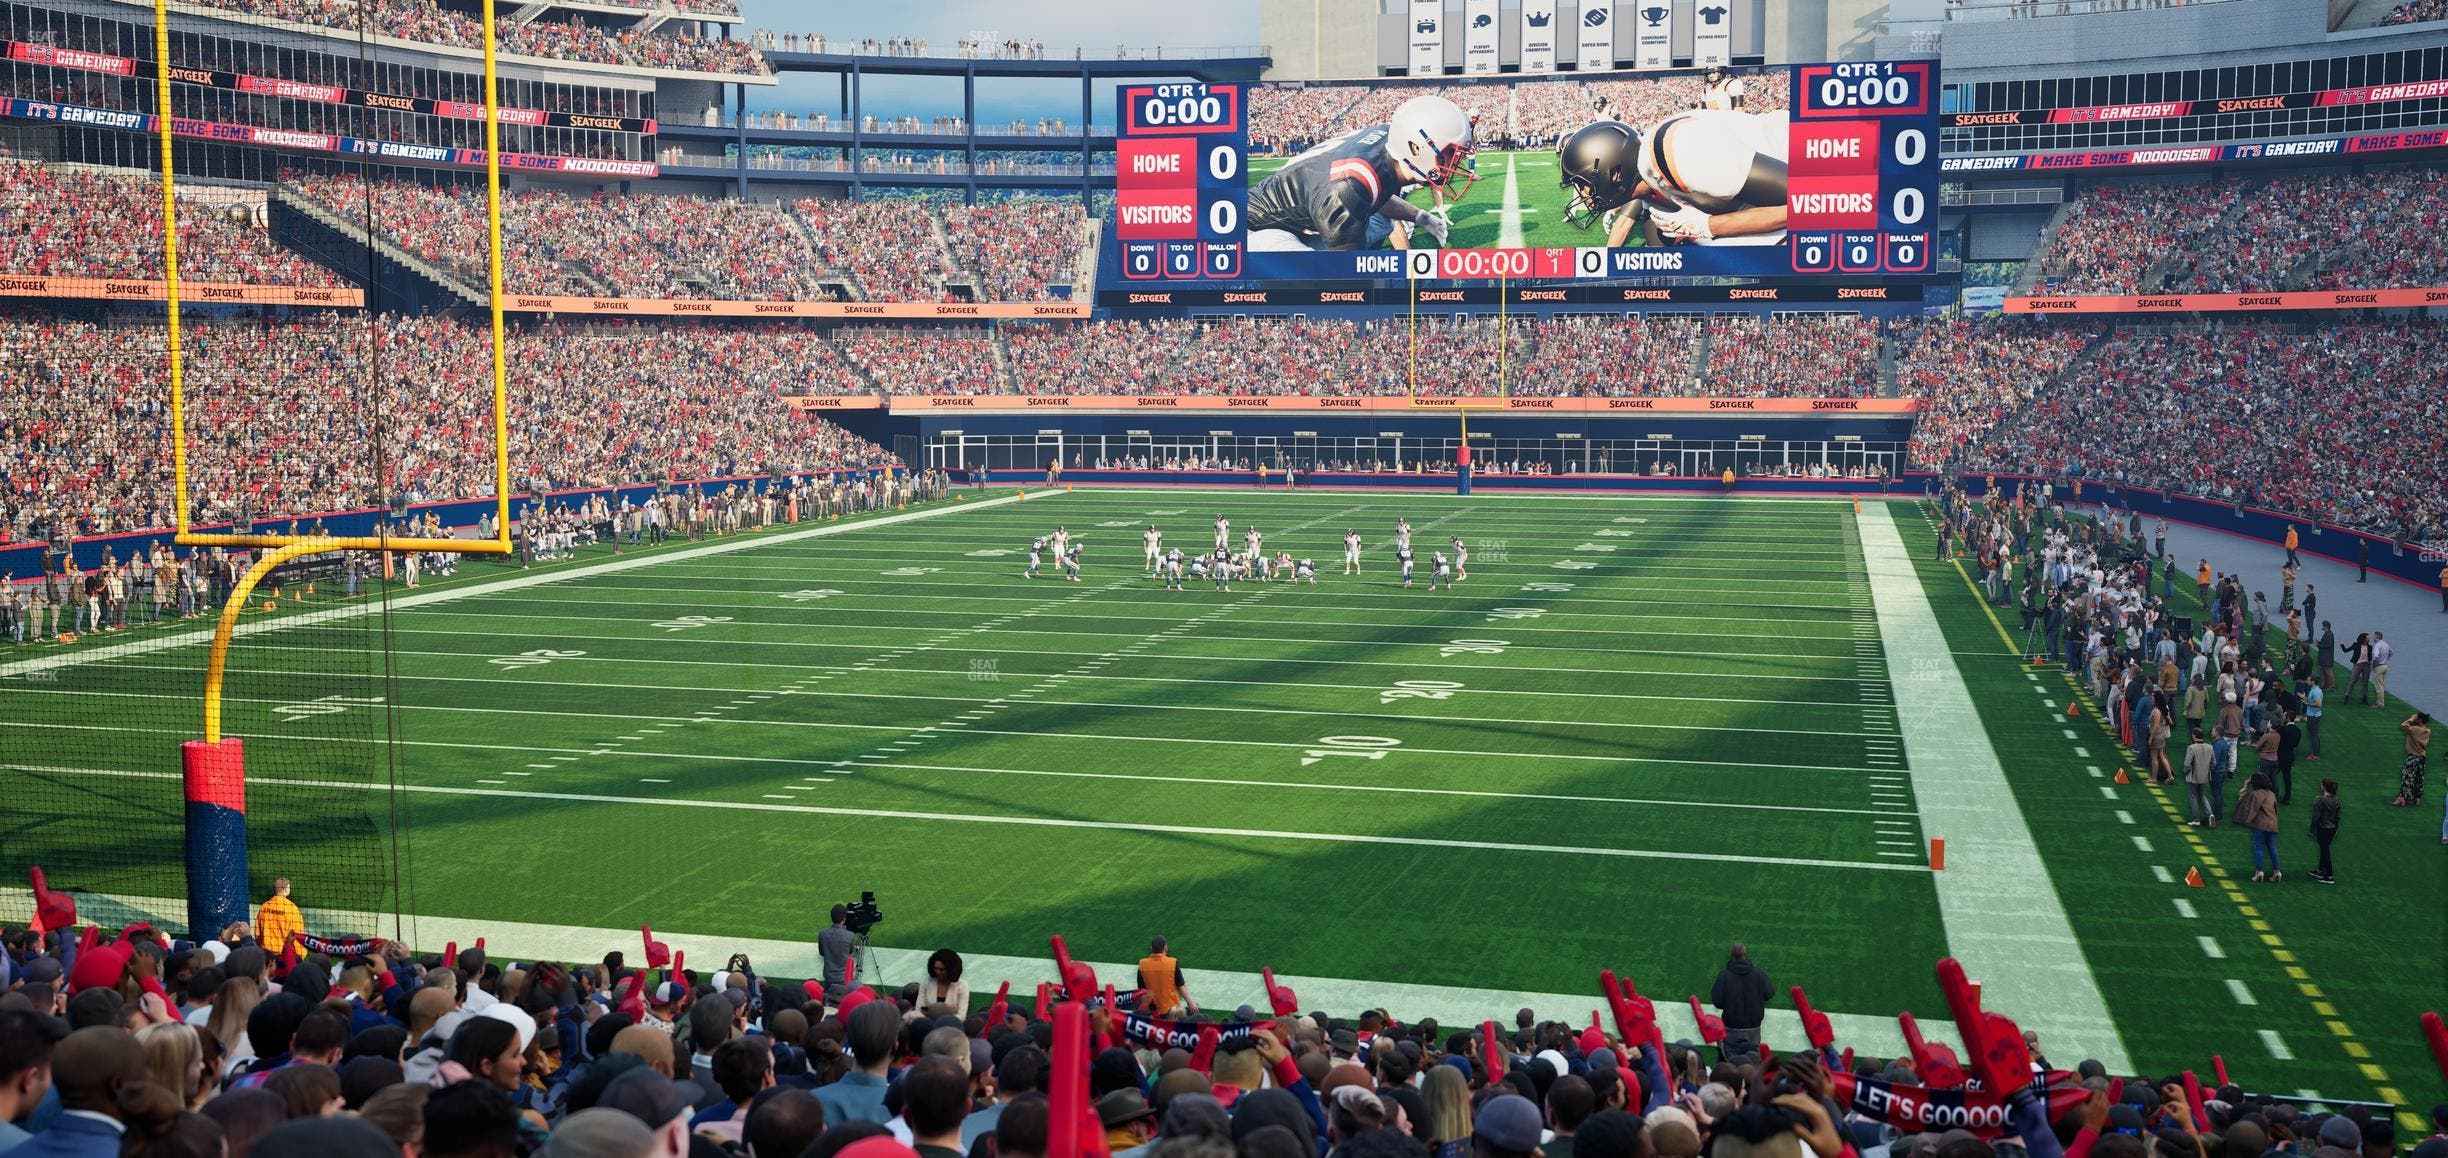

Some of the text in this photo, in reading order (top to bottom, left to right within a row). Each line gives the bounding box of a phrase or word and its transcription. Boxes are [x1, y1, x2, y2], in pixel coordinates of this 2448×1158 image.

[56, 50, 123, 72] GAMEDAY!
[168, 67, 213, 86] EATGEEK
[1836, 62, 1893, 77] QTR 1
[277, 81, 335, 100] GAMEDAY!
[1157, 84, 1206, 98] QTR 1
[1821, 76, 1909, 106] 0:00
[2337, 88, 2368, 104] IT'S
[366, 93, 415, 111] SEATGEEK
[2217, 96, 2285, 113] SEATGEEK
[26, 102, 142, 129] IT'S GAMEDAY!
[450, 104, 473, 116] IT'S
[1145, 97, 1221, 125] 0:00
[2069, 104, 2176, 121] IT'S GAMEDAY!
[569, 115, 623, 130] SEATGEEK
[1955, 111, 2020, 126] SEATGEEK
[212, 124, 249, 140] SOME
[1806, 138, 1860, 159] HOME
[1894, 128, 1926, 166] 0
[2358, 132, 2443, 150] MAKE SOME
[352, 139, 448, 161] IT'S GAMEDAY!
[2040, 146, 2211, 167] MAKE SOME NOOOOISE!!!
[2235, 140, 2338, 159] IT'S GAMEDAY!
[518, 156, 560, 169] SOME
[563, 158, 655, 176] NOOOOISE!!!
[1133, 154, 1180, 173] HOME
[1209, 145, 1237, 180] 0
[1941, 156, 2019, 171] GAMEDAY!
[1791, 193, 1873, 214] VISITORS
[1893, 187, 1925, 225] 0
[1121, 205, 1192, 225] VISITORS
[1209, 199, 1237, 235] 0
[1800, 236, 1828, 244] DOWN
[1846, 235, 1874, 243] TO GO
[1889, 234, 1923, 243] BALL ON
[1545, 248, 1565, 257] QRT
[1805, 246, 1822, 264] 0
[1851, 246, 1868, 264] 0
[1898, 245, 1914, 263] 0
[1135, 254, 1149, 271] 0
[1175, 254, 1189, 271] 0
[1215, 253, 1229, 270] 0
[1356, 255, 1399, 273] HOME
[1413, 253, 1432, 275] 0
[1443, 251, 1529, 275] 00:00
[1551, 258, 1559, 274] 1
[1582, 253, 1602, 274] 0
[1615, 252, 1683, 271] VISITORS
[0, 278, 46, 292] SEATGEEK
[106, 283, 149, 296] SEATGEEK
[202, 287, 243, 300] SEATGEEK
[294, 290, 333, 302] SEATGEEK
[1128, 292, 1172, 304] SEATGEEK
[1223, 292, 1267, 303] SEATGEEK
[1320, 291, 1364, 302] SEATGEEK
[1419, 290, 1464, 302] SEATGEEK
[1520, 289, 1567, 301] SEATGEEK
[1624, 289, 1671, 300] SEATGEEK
[1729, 288, 1778, 299] SEATGEEK
[1837, 287, 1887, 299] SEATGEEK
[2335, 294, 2377, 304] SEATGEEK
[517, 299, 552, 309] SEATGEEK
[593, 301, 629, 310] SEATGEEK
[673, 302, 712, 312] SEATGEEK
[755, 304, 794, 313] SEATGEEK
[2029, 300, 2077, 310] SEATGEEK
[2137, 298, 2182, 308] SEATGEEK
[2238, 296, 2282, 306] SEATGEEK
[843, 305, 885, 314] SEATGEEK
[936, 306, 978, 315] SEATGEEK
[1034, 306, 1078, 316] SEATGEEK
[801, 398, 842, 408] SEATGEEK
[932, 397, 974, 407] SEATGEEK
[1027, 397, 1070, 407] SEATGEEK
[1137, 398, 1178, 407] SEATGEEK
[1228, 398, 1269, 407] SEATGEEK
[1320, 398, 1362, 407] SEATGEEK
[1510, 399, 1554, 408] SEATGEEK
[1609, 399, 1653, 409] SEATGEEK
[1709, 400, 1754, 409] SEATGEEK
[1812, 401, 1858, 410] SEATGEEK
[1380, 680, 1466, 700] 20
[1304, 735, 1402, 760] 10
[304, 936, 327, 953] LET'S
[1126, 1016, 1165, 1043] LET'S
[1854, 1081, 1915, 1121] LET'S
